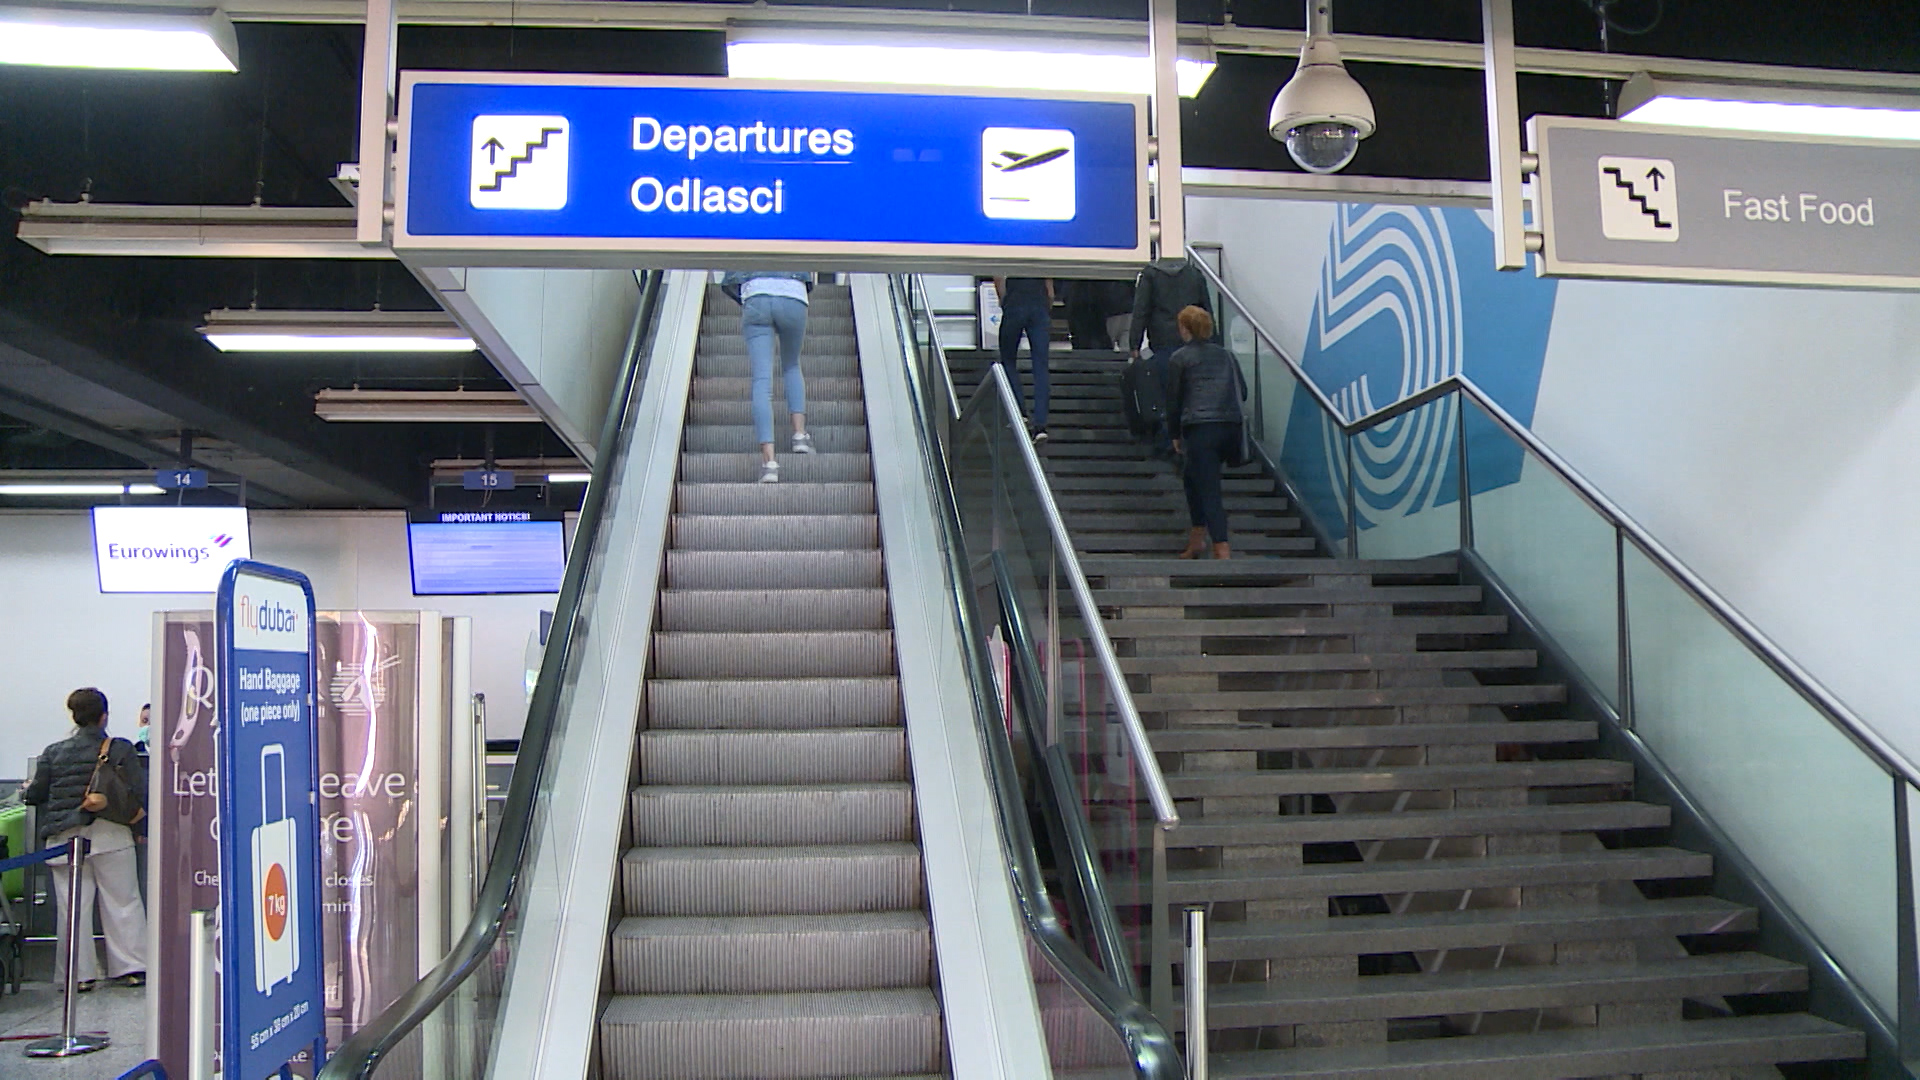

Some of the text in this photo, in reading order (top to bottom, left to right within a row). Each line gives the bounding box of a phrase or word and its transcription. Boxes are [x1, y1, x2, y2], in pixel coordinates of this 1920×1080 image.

[631, 117, 855, 160] Departures
[630, 176, 784, 214] Odlasci
[1723, 189, 1875, 226] Fast Food
[174, 473, 191, 486] 14
[481, 473, 498, 486] 15
[441, 512, 493, 523] IMPORTANT
[108, 542, 210, 564] Eurowings
[240, 594, 298, 636] flydubai
[239, 667, 264, 690] Hand
[265, 667, 300, 695] Baggage
[240, 700, 300, 728] (one piece only)
[173, 762, 218, 797] Let
[319, 771, 406, 799] eave
[322, 897, 354, 913] min
[260, 1029, 269, 1044] cm
[281, 1014, 290, 1028] cm
[301, 1001, 309, 1014] cm
